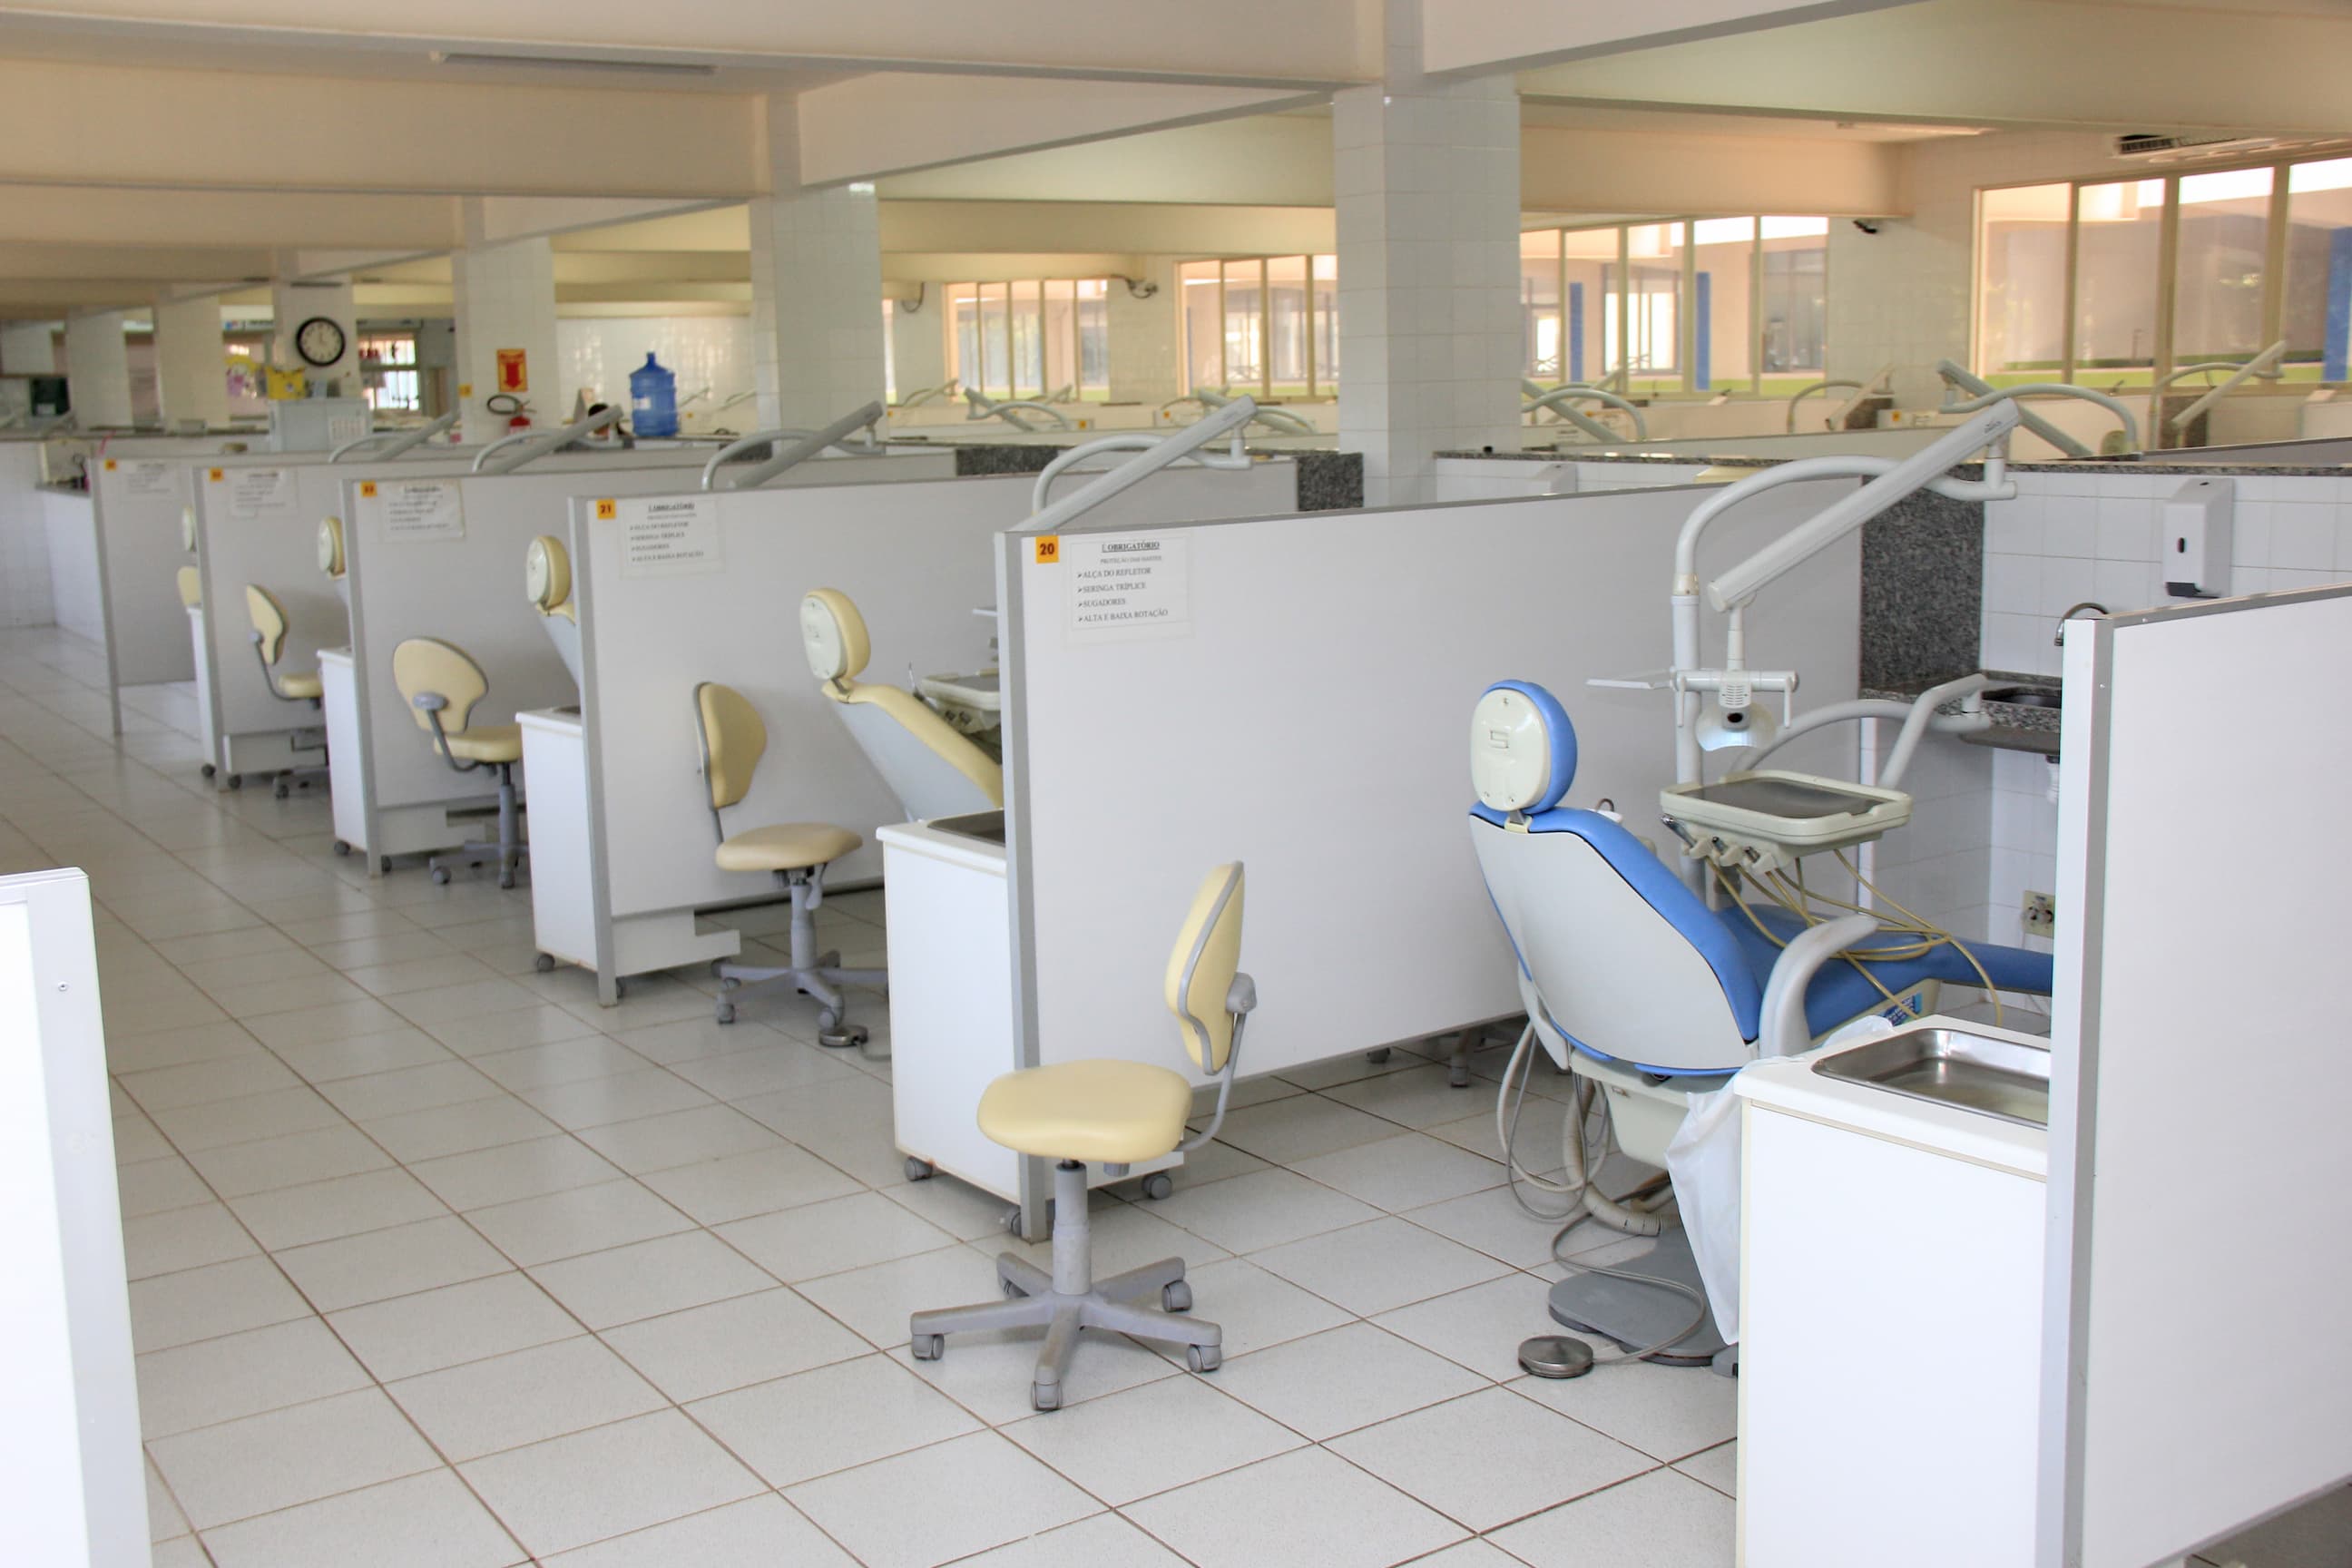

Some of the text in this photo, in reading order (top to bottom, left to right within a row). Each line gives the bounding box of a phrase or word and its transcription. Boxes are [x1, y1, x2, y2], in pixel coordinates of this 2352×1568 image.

[1039, 543, 1054, 554] 20
[1107, 541, 1160, 551] OBRIGATÓRIO
[1083, 571, 1102, 579] ALÇA
[1115, 568, 1151, 576] REFLETOR
[1083, 584, 1115, 593] SERINGA
[1083, 598, 1126, 607] SUGADORES
[1083, 614, 1102, 622] ALTA
[1110, 612, 1132, 621] BAIXA
[1134, 608, 1168, 618] ROTAÇÃO
